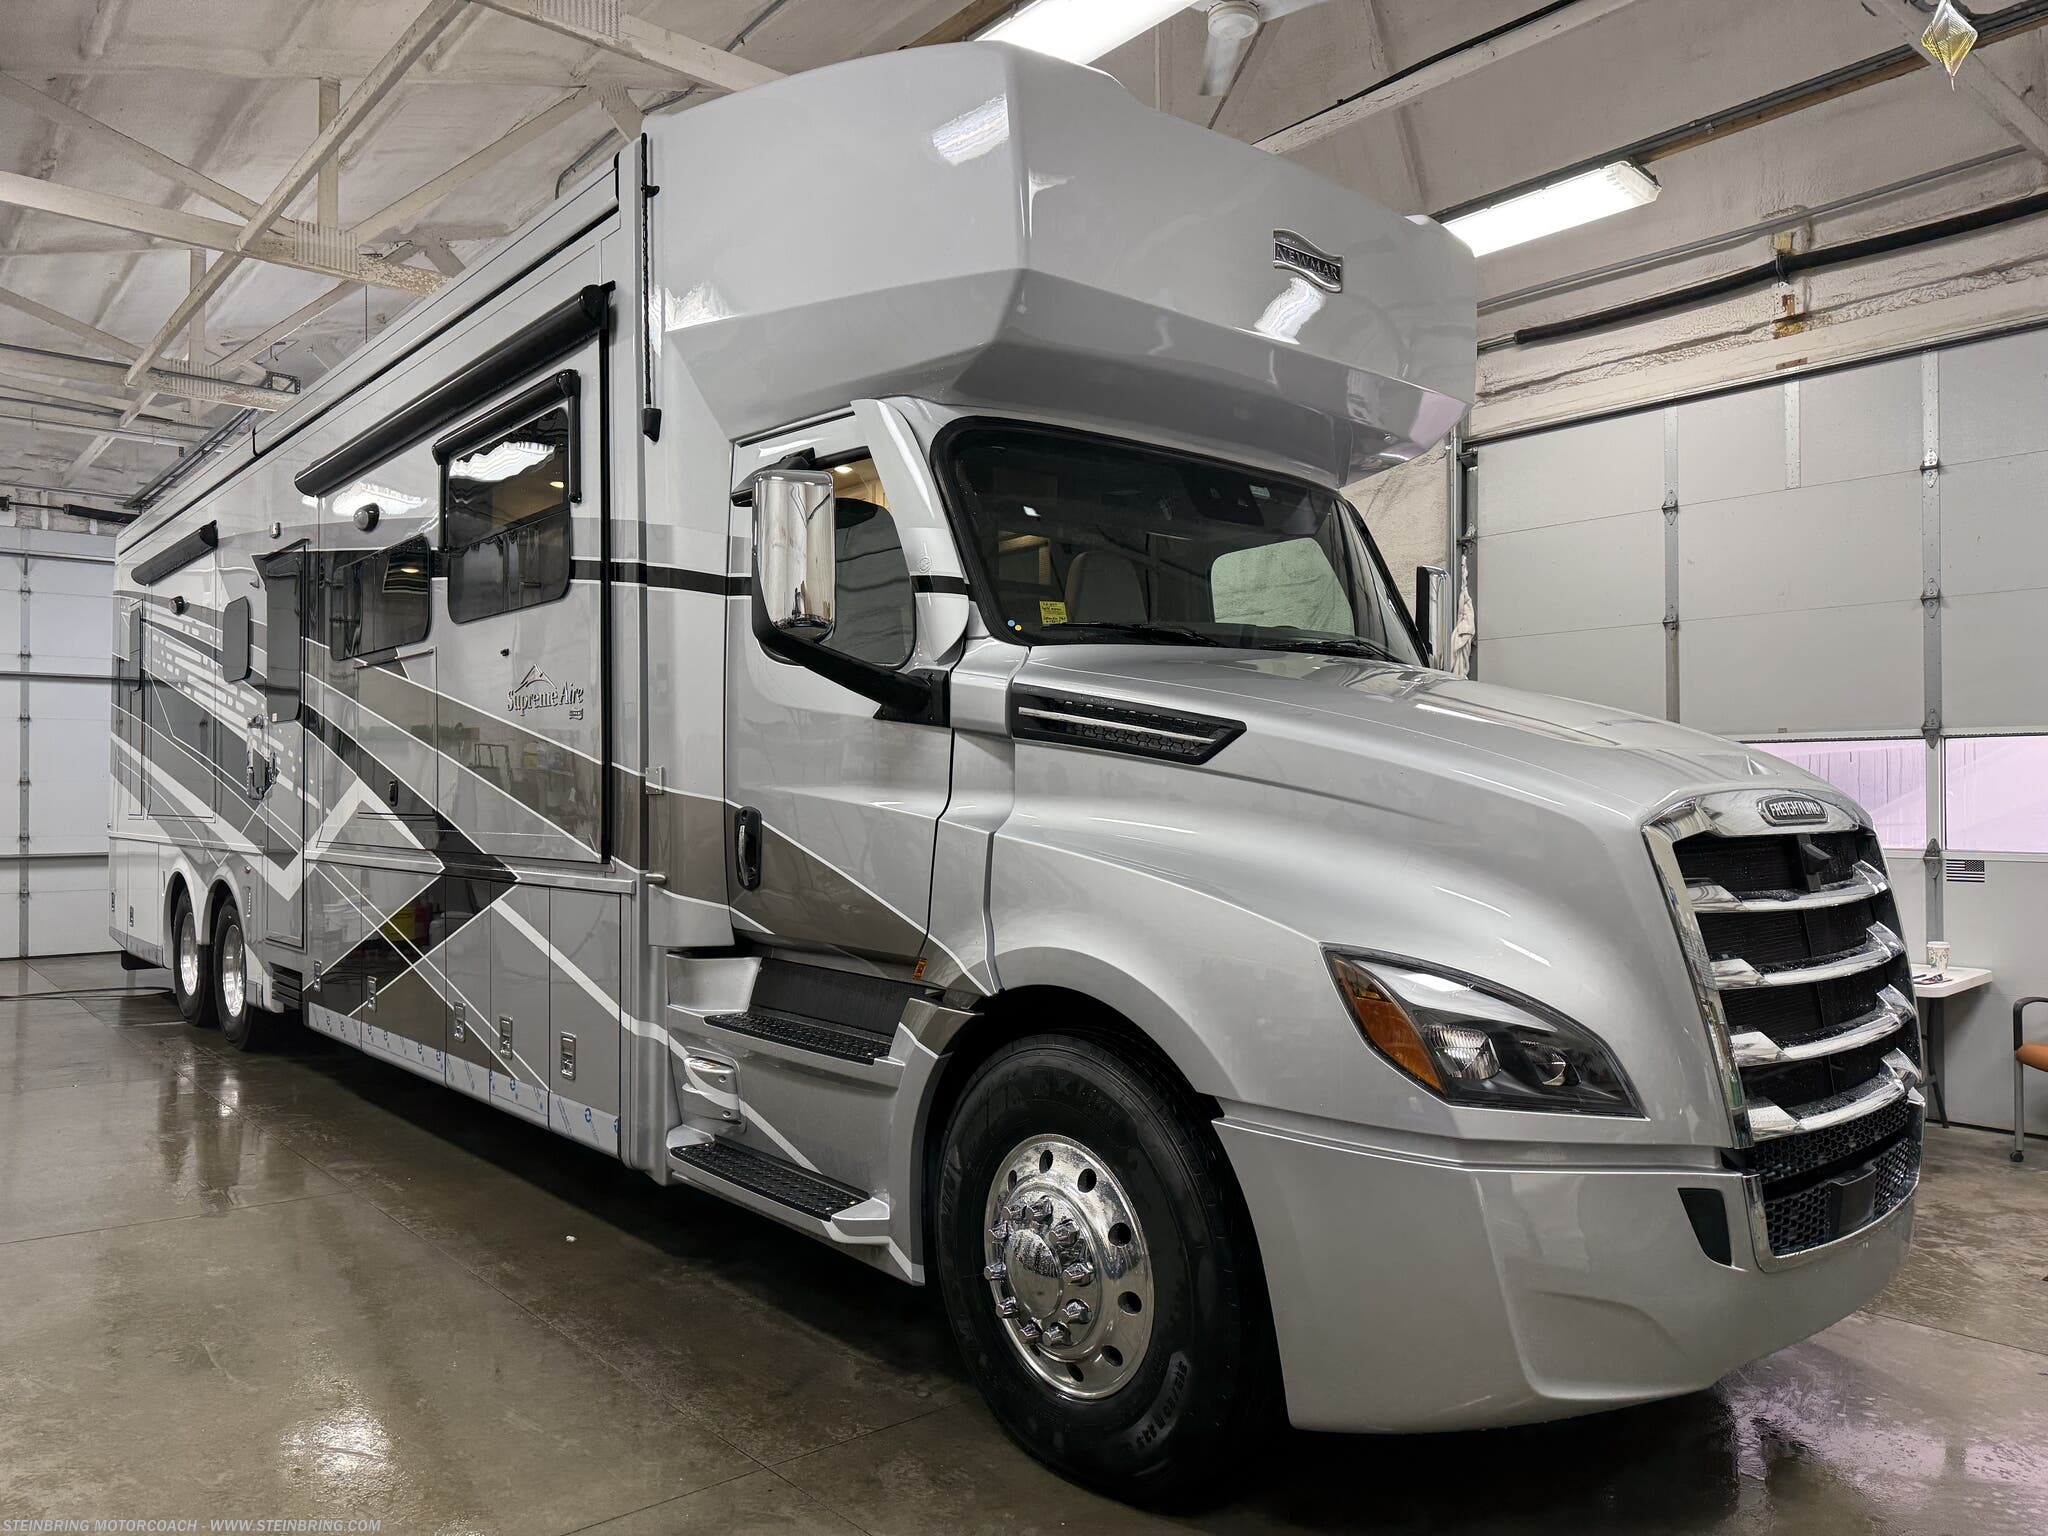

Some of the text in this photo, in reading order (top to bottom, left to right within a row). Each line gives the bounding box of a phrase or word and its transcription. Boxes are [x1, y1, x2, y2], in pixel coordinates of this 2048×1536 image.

[1275, 246, 1339, 281] NEWMAR
[507, 689, 558, 716] Supreme
[559, 681, 584, 706] Aire
[1768, 800, 1824, 817] FREIGHTLINER
